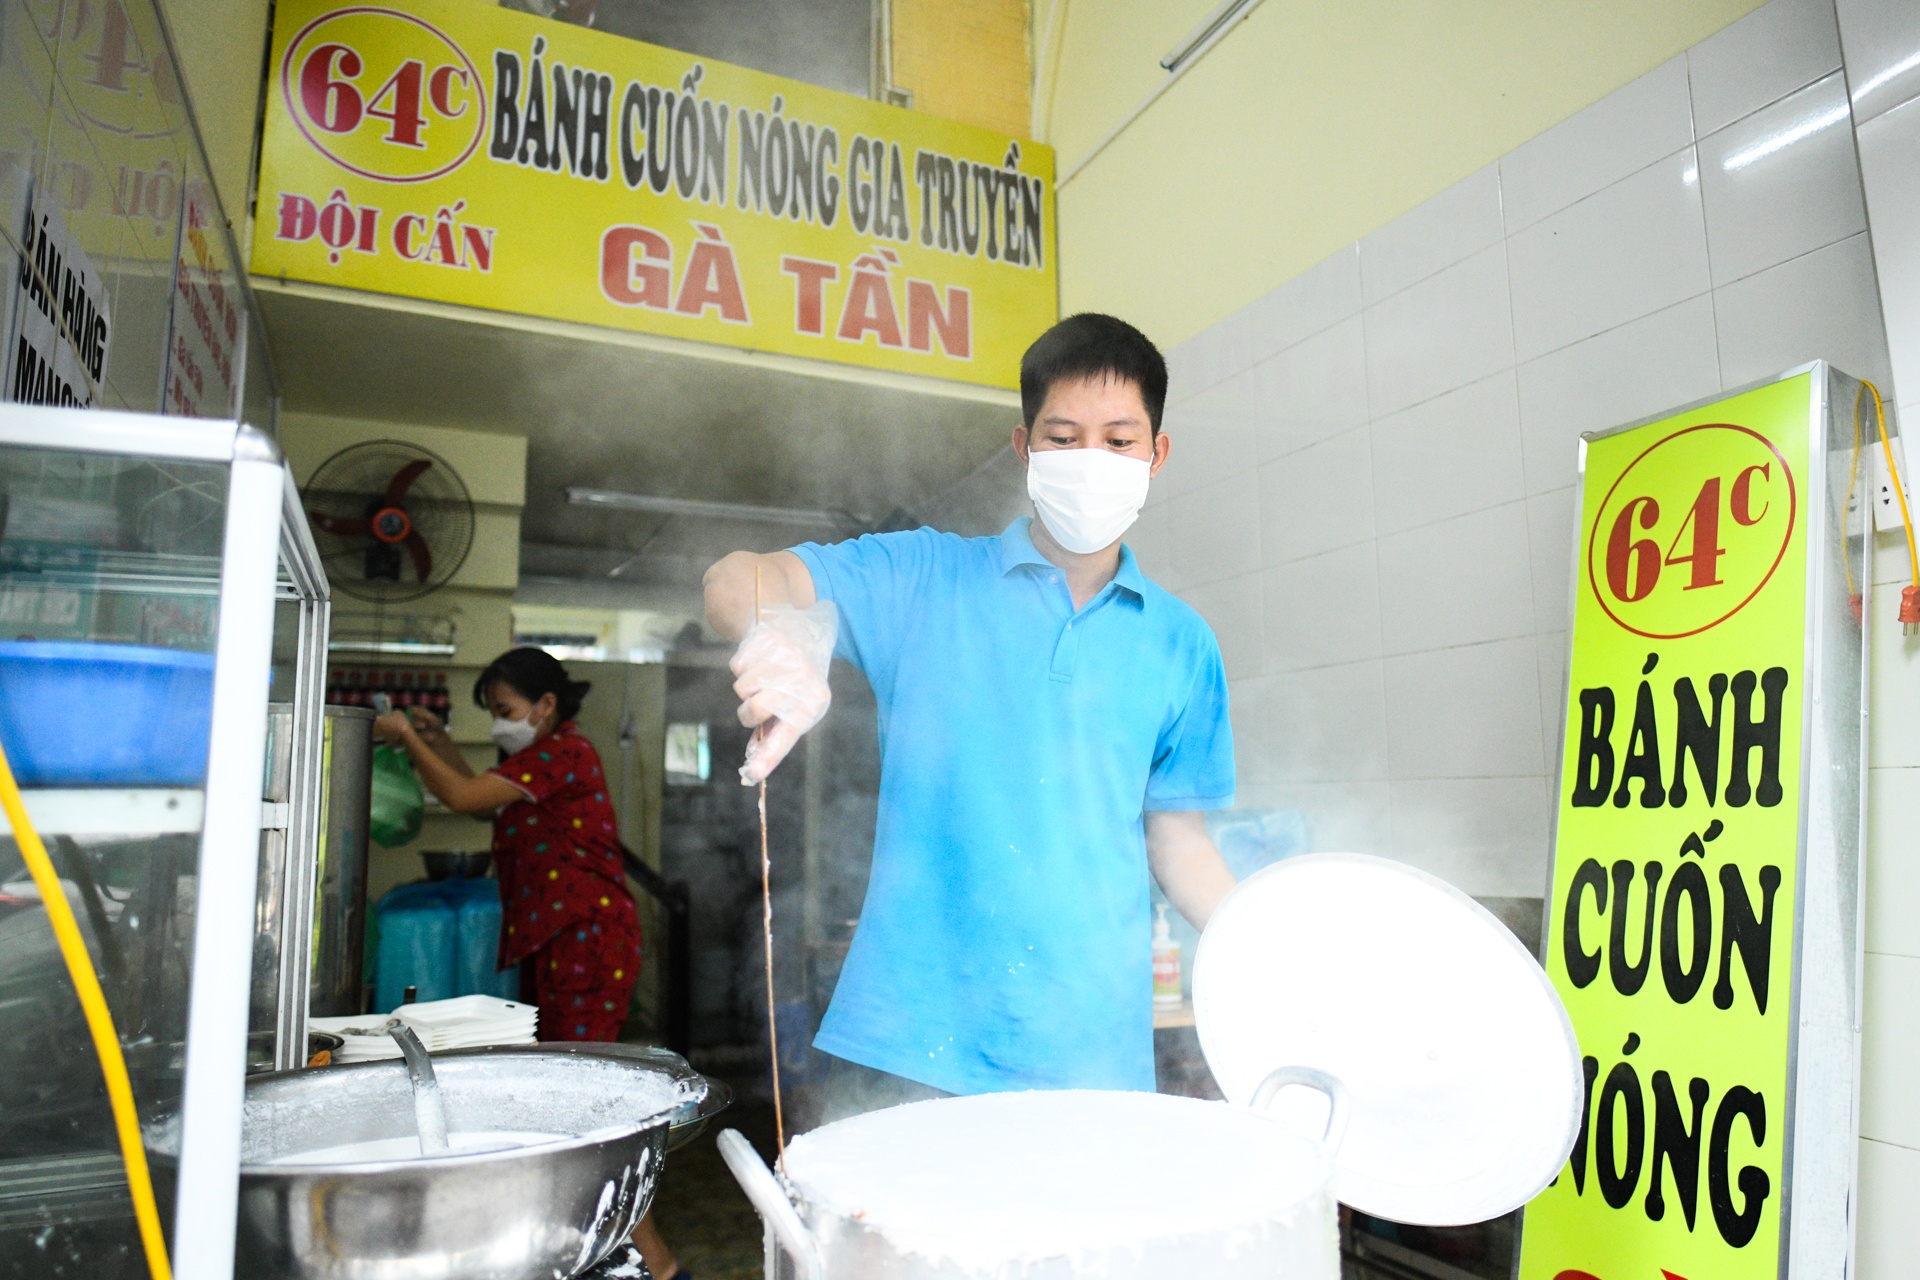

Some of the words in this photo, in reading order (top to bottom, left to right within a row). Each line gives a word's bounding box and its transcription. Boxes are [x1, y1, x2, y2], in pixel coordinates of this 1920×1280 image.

[277, 190, 380, 264] ĐỘI
[393, 200, 496, 271] CẤN
[490, 37, 612, 181] BÁNH
[621, 63, 729, 204] CUỐN
[737, 96, 839, 226] NÓNG
[848, 136, 909, 241] GIA
[917, 142, 1042, 268] TRUYỀN
[600, 222, 750, 324] GÀ
[782, 247, 972, 360] TẦN
[1571, 652, 1789, 808] BÁNH
[1563, 819, 1781, 1016] CUỐN
